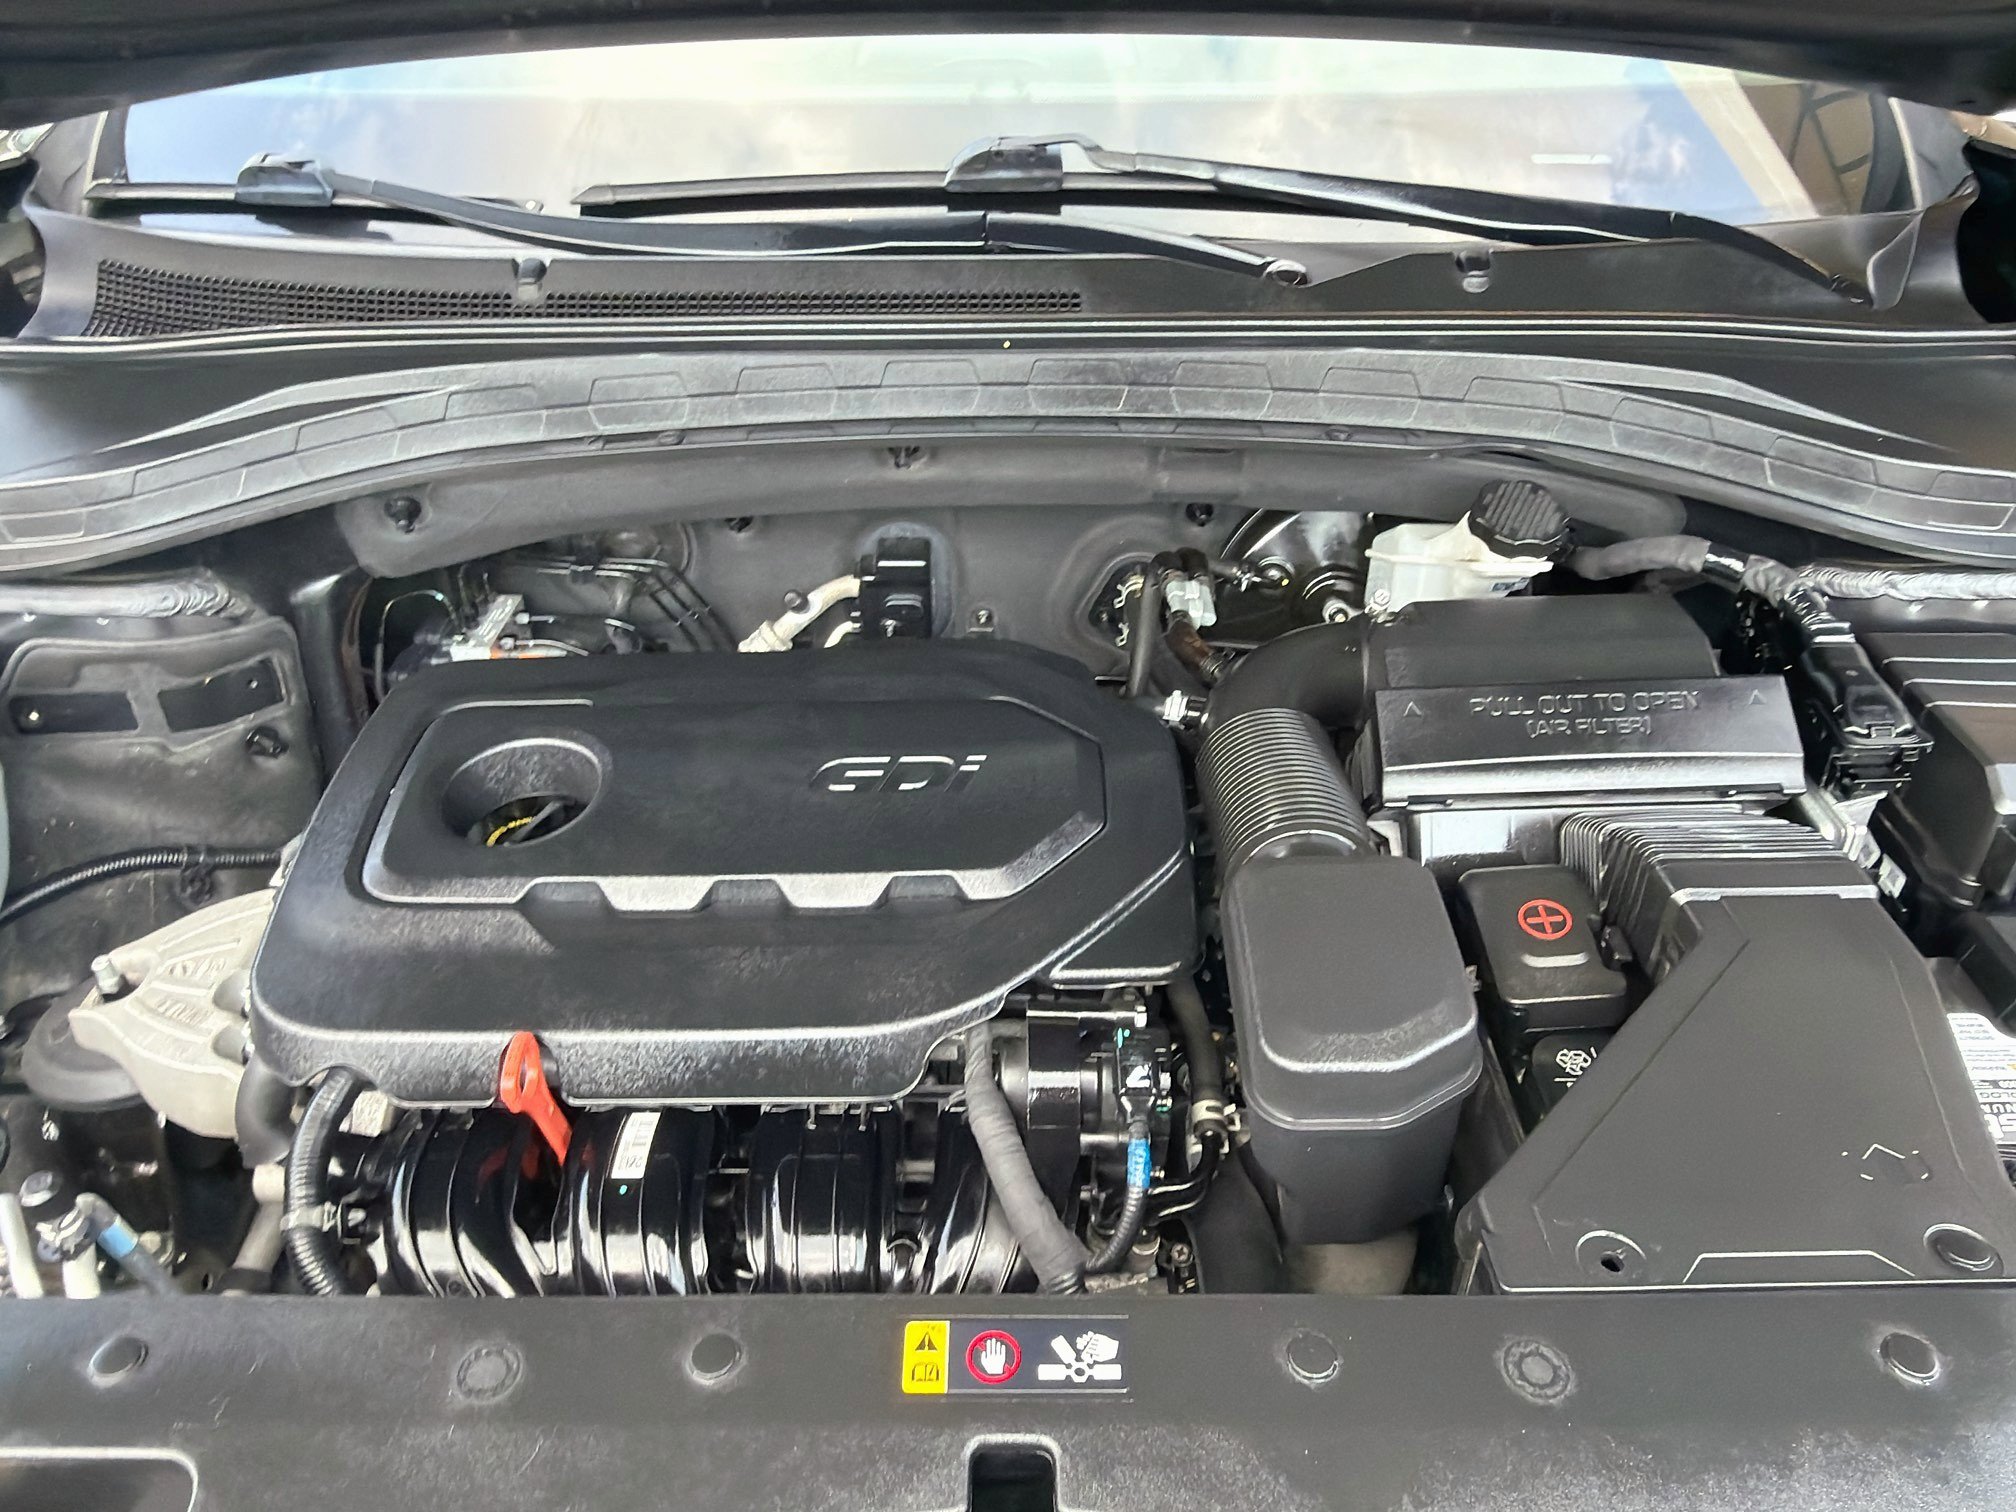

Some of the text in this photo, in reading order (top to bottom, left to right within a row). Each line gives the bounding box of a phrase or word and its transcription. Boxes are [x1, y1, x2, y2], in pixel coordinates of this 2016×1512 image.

[1468, 689, 1701, 716] PULL OUT TO OPEN
